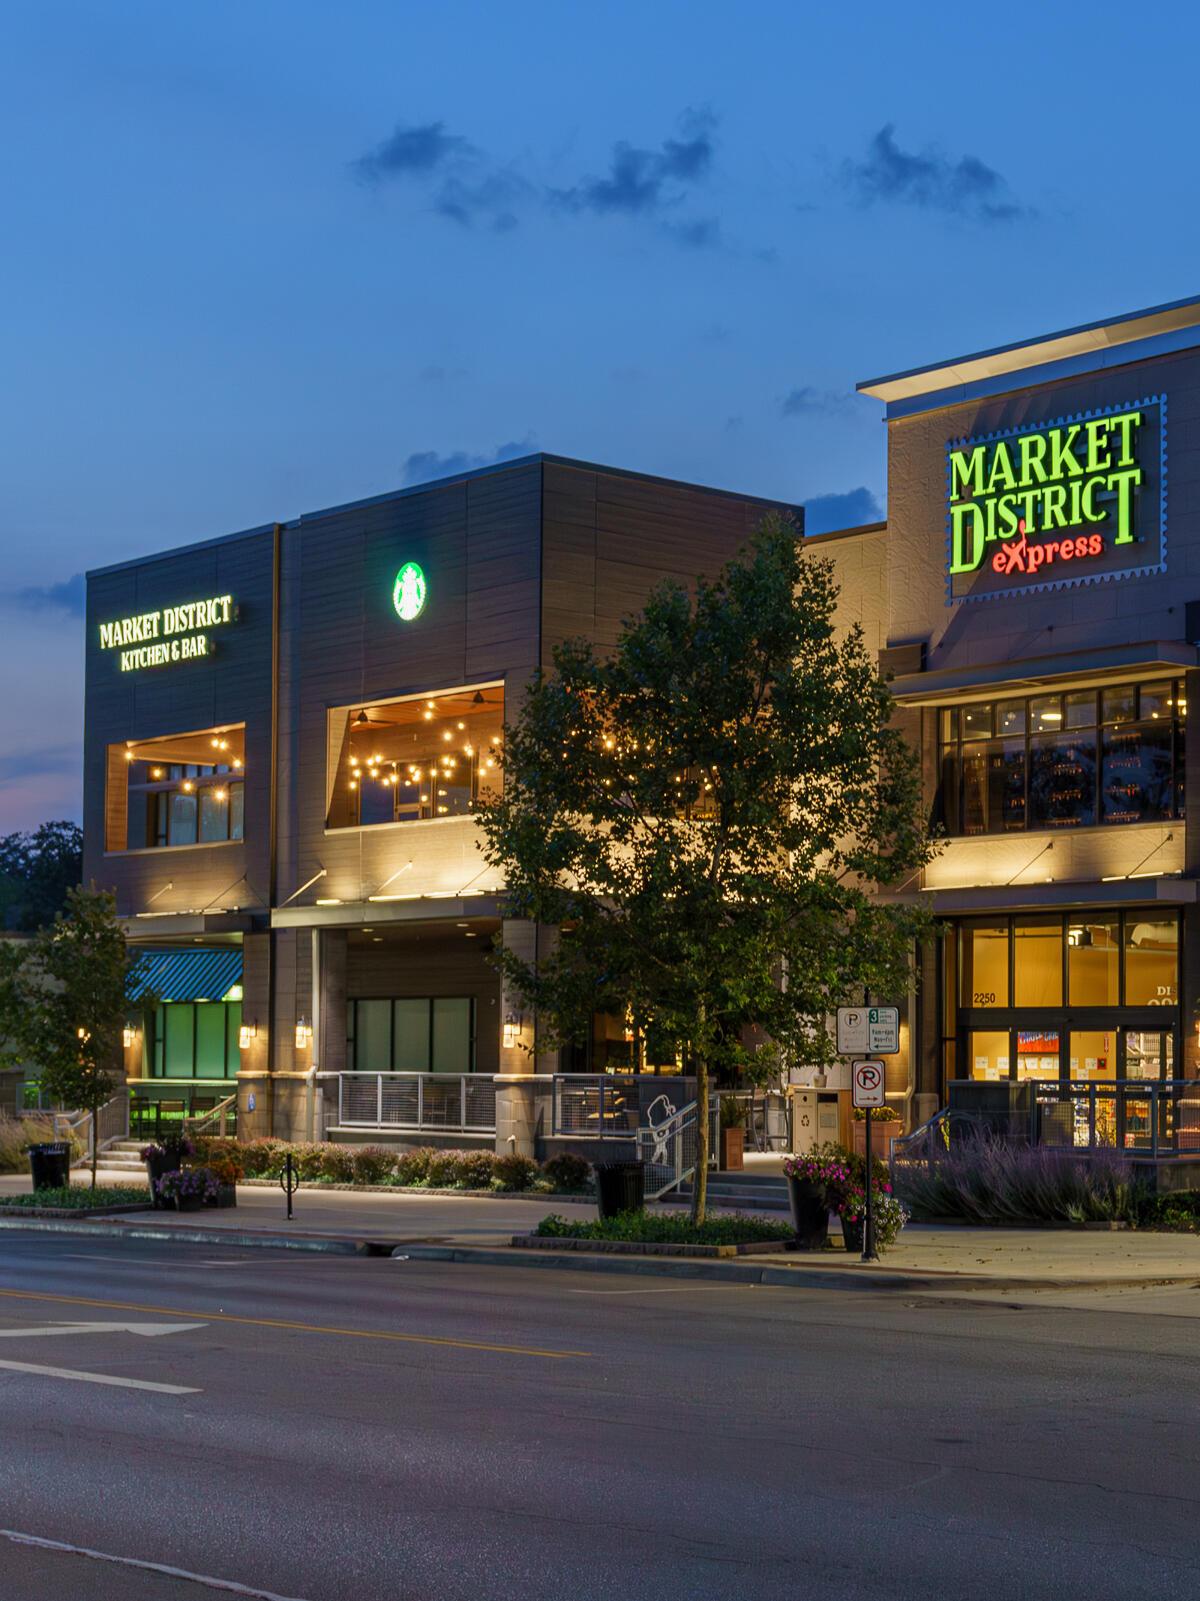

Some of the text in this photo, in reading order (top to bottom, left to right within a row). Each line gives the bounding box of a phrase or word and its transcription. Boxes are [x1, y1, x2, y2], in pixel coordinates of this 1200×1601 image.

[949, 411, 1142, 502] MARKET
[949, 468, 1142, 575] DISTRICT
[99, 595, 232, 650] MARKET DISTRICT
[120, 634, 207, 672] KITCHEN & BAR
[870, 1010, 877, 1022] 3
[974, 992, 995, 1004] 2250
